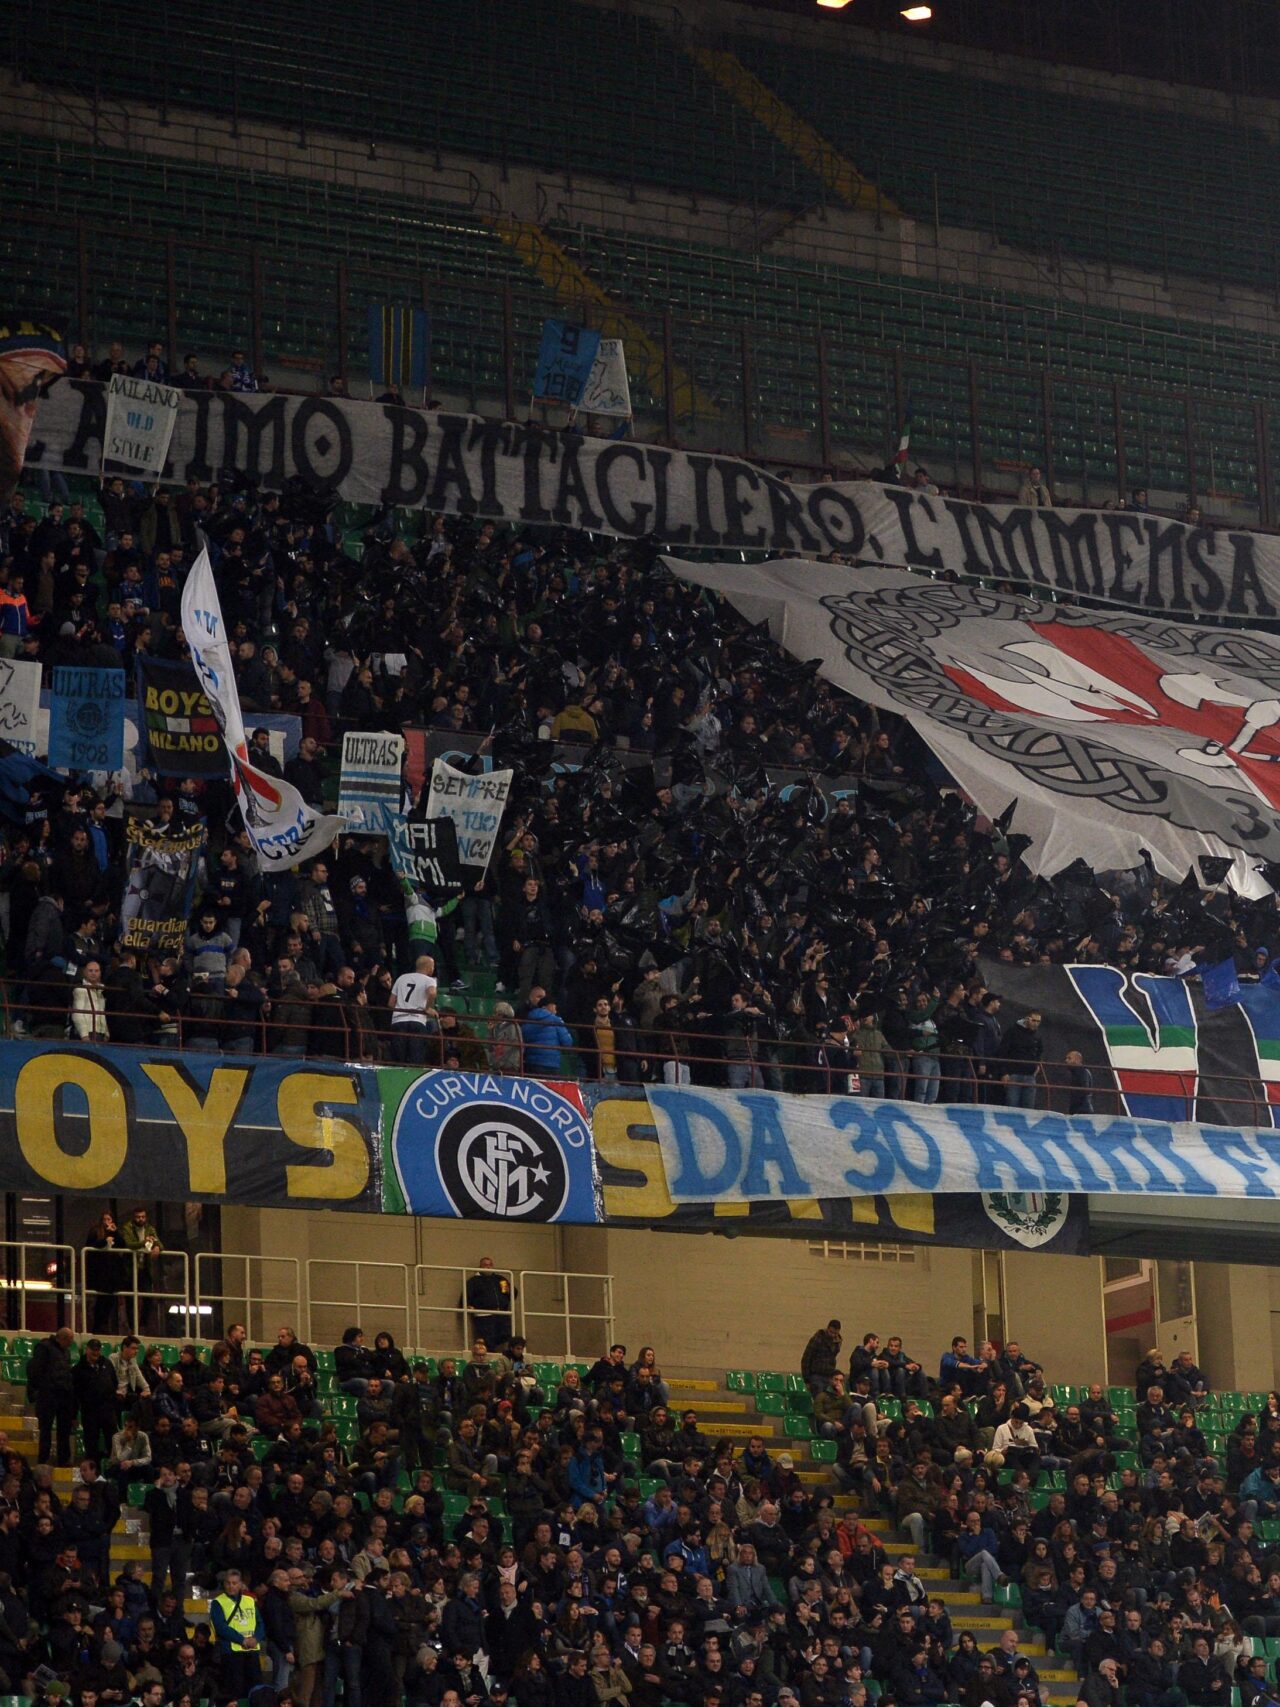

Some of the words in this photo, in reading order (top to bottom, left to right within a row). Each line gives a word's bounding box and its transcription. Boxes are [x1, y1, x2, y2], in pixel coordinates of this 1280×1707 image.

[110, 376, 180, 409] MILANO
[381, 402, 884, 560] BATTAGLIERO,
[884, 488, 1277, 617] L'IMMENSA
[53, 668, 123, 698] ULTRAS
[146, 687, 213, 716] BOYS
[149, 733, 219, 752] MILANO
[344, 737, 399, 767] ULTRAS
[433, 773, 509, 802] SEMPRE
[393, 818, 438, 850] MAI
[405, 983, 416, 1003] 7
[416, 1074, 503, 1119] CURVA
[511, 1081, 586, 1148] NORD
[650, 1089, 812, 1197] DA
[829, 1101, 943, 1193] 30
[945, 1107, 1219, 1196] ANNI
